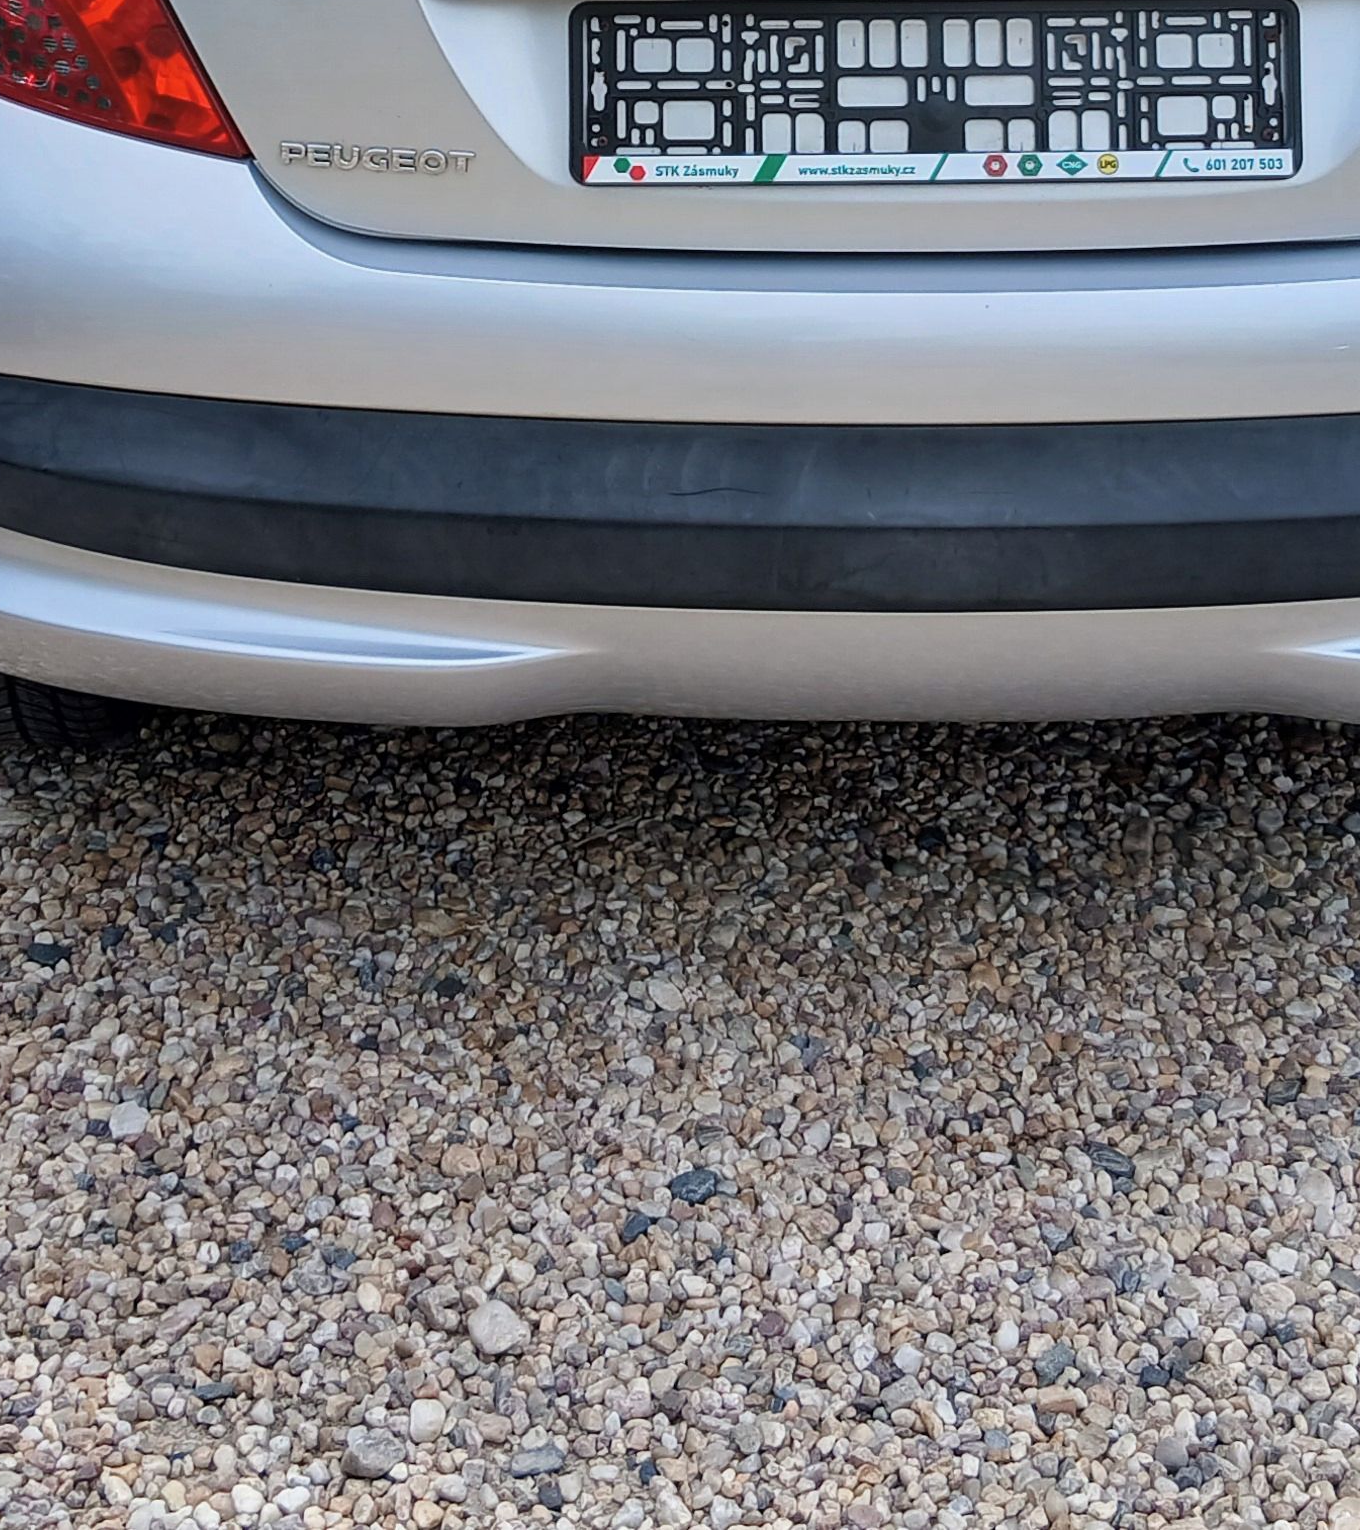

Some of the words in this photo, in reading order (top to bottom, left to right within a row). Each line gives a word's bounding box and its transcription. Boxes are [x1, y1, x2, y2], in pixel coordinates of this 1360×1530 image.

[280, 140, 477, 175] PEUGEOT
[1099, 159, 1117, 169] LPG
[1205, 158, 1226, 172] 601
[1231, 158, 1254, 171] 207
[1259, 157, 1284, 171] 503
[655, 165, 680, 177] STK
[682, 163, 739, 179] Zásmuky
[797, 164, 917, 178] www.stkzasmuky.cz
[1061, 161, 1081, 169] CNG
